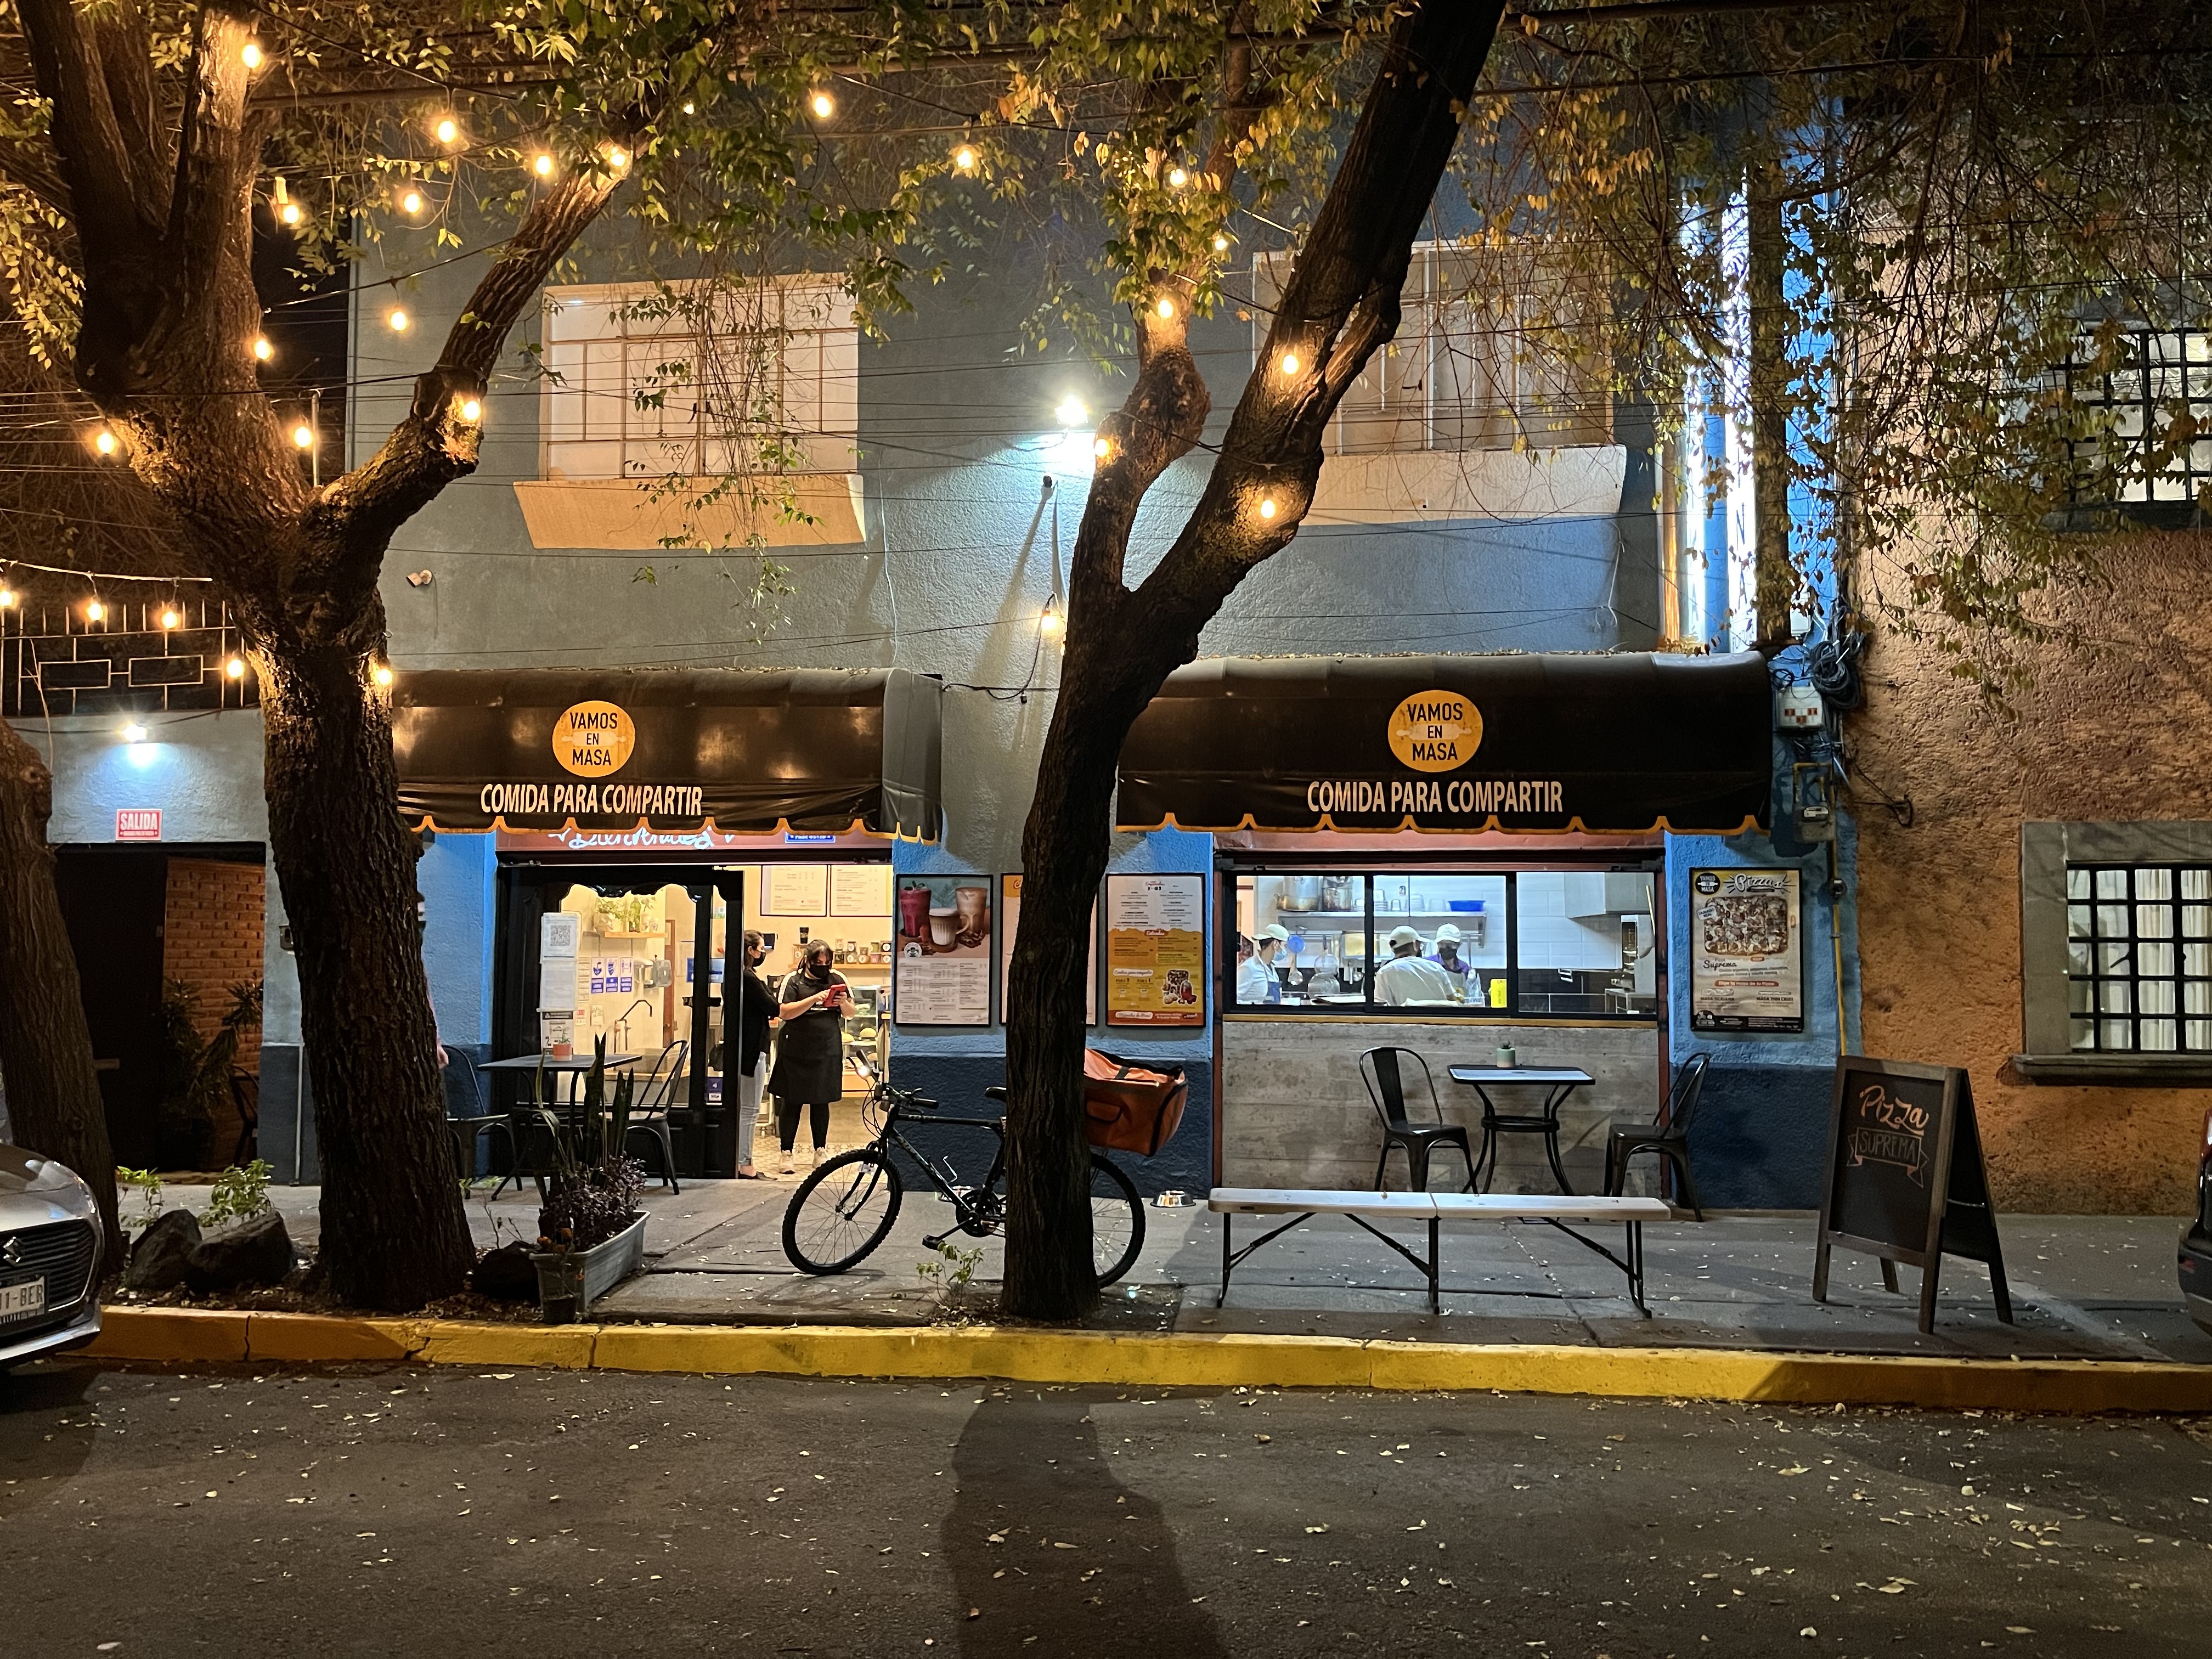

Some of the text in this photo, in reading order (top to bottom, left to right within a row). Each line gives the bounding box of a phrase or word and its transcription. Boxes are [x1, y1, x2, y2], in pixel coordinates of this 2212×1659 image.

[569, 712, 618, 729] VAMOS
[1407, 702, 1463, 721] VAMOS
[586, 733, 599, 745] EN
[1427, 725, 1442, 739] EN
[572, 749, 612, 766] MASA
[1412, 742, 1458, 761] MASA
[481, 783, 702, 816] COMIDA PARA COMPARTIR
[1307, 781, 1562, 812] COMIDA PARA COMPARTIR
[120, 812, 158, 831] SALIDA
[1703, 960, 1737, 971] Suprema
[1860, 1085, 1929, 1136] Pizza
[1859, 1131, 1915, 1164] SUPREMA
[0, 1284, 43, 1311] 1-BER
